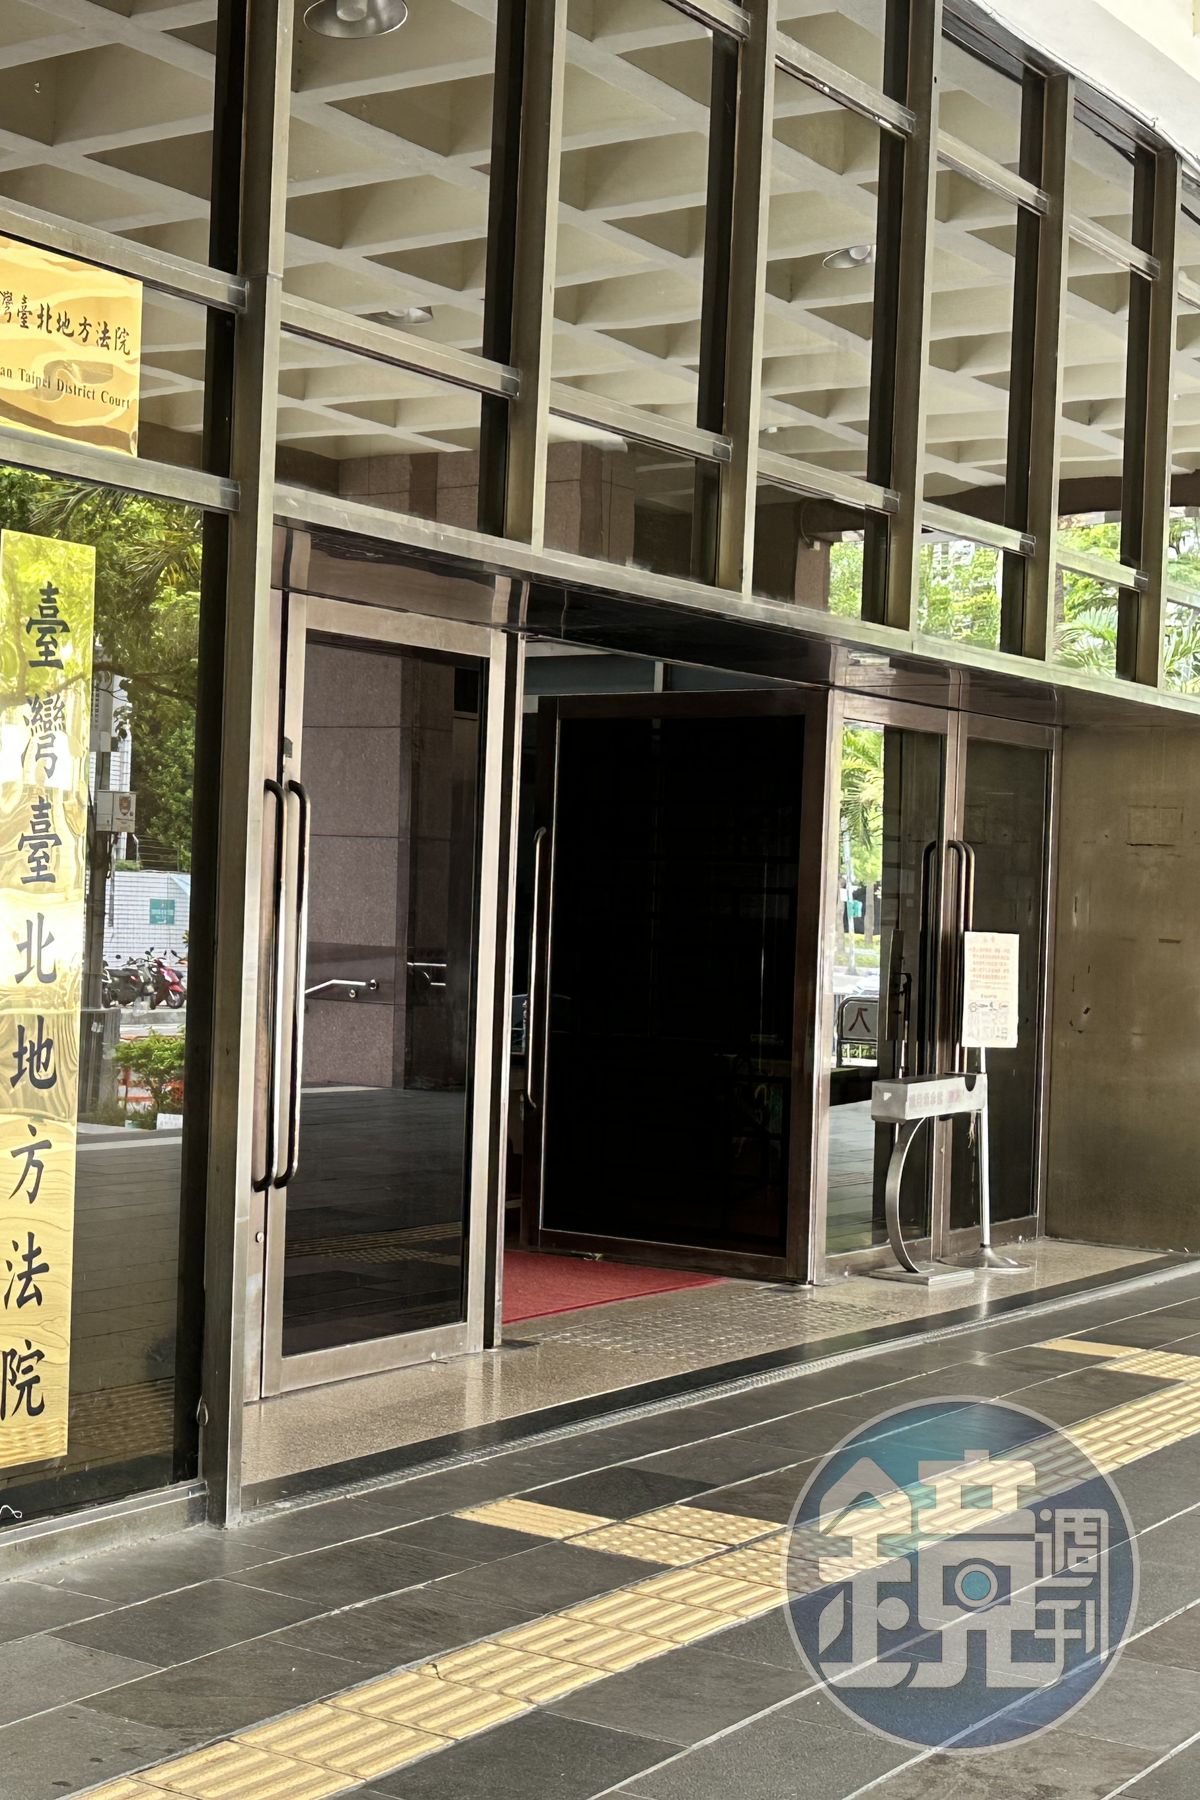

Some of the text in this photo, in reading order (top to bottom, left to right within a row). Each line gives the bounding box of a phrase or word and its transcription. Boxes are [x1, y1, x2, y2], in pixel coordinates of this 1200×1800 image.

[19, 368, 52, 390] Taipei
[56, 378, 96, 401] District
[100, 390, 131, 409] Court
[0, 580, 71, 1421] 臺灣臺北地方法院
